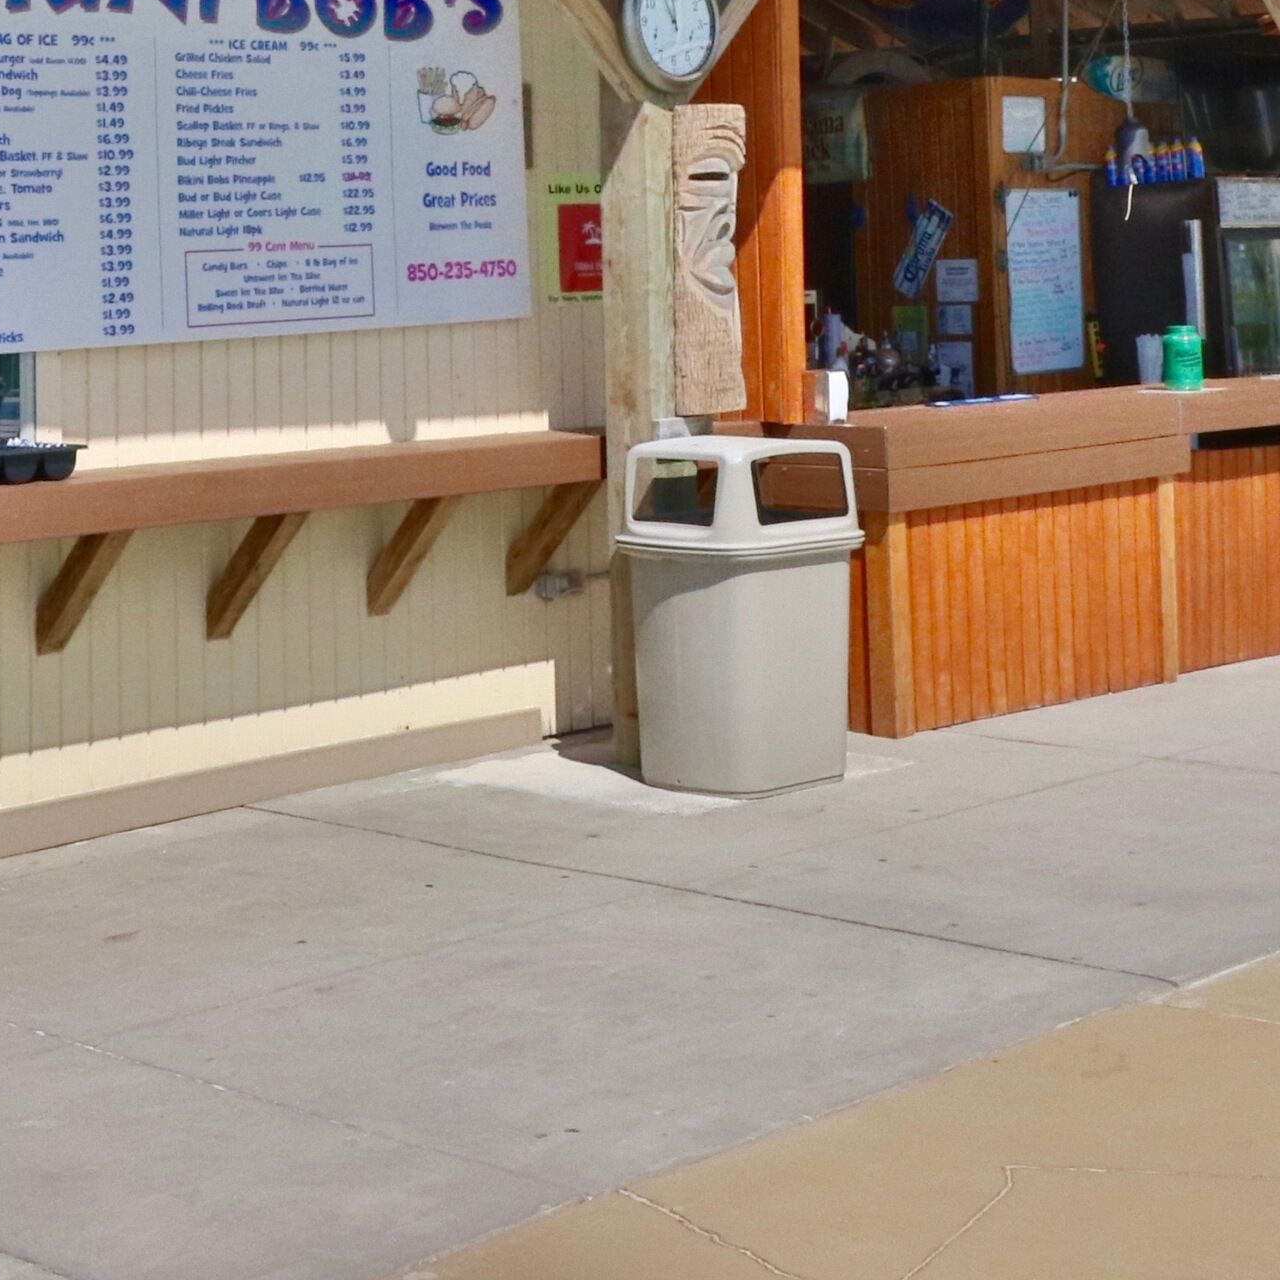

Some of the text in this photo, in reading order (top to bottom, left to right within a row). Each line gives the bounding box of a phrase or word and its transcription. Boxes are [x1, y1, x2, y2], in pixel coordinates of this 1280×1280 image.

[16, 33, 34, 46] OF
[38, 33, 58, 47] ICE
[228, 39, 247, 51] ICE
[250, 39, 288, 51] CREAM
[95, 54, 128, 66] $4.49
[175, 52, 366, 65] Grilled Chicken Salad $5.99
[95, 70, 128, 82] $3.99
[175, 69, 366, 81] Cheese Fries $3.49
[0, 85, 22, 100] Dog
[95, 86, 128, 97] $3.99
[176, 86, 367, 97] Chili-Cheese Fries $4.99
[96, 102, 125, 113] $1.49
[176, 103, 366, 114] Fried Pickles $3.99
[96, 118, 125, 129] $1.49
[176, 120, 210, 132] Scallop
[340, 120, 370, 131] $10.99
[97, 134, 130, 144] $6.99
[176, 137, 368, 150] Ribeye Steak Sandwich $6.99
[97, 149, 134, 160] $10.99
[177, 154, 368, 167] Bud Light Pitcher $5.99
[98, 166, 130, 176] $2.99
[425, 160, 491, 177] Good Food
[177, 174, 204, 186] Bikini
[207, 174, 230, 185] Bobs
[233, 174, 276, 186] Pineapple
[11, 183, 53, 194] Tomato
[98, 181, 130, 192] $3.99
[548, 183, 603, 195] Like Us O
[99, 197, 131, 207] $3.99
[178, 188, 375, 204] Bud or Bud Light Case $22.95
[422, 190, 497, 209] Great Prices
[99, 213, 132, 224] $6.99
[179, 205, 375, 221] Miller Light or Coors Light Case $22.95
[179, 226, 214, 238] Natural
[217, 225, 239, 238] Light
[344, 222, 373, 233] $12.99
[10, 231, 64, 244] Sandwich
[100, 229, 132, 240] $4.99
[100, 245, 132, 256] $3.99
[248, 240, 315, 252] 99 Cent Menu
[101, 261, 133, 271] $3.99
[202, 261, 248, 273] Candy Bars
[407, 258, 517, 283] 850-235-4750
[101, 277, 130, 288] $1.99
[102, 293, 134, 304] $2.49
[103, 309, 131, 320] $1.99
[103, 325, 135, 336] $3.99
